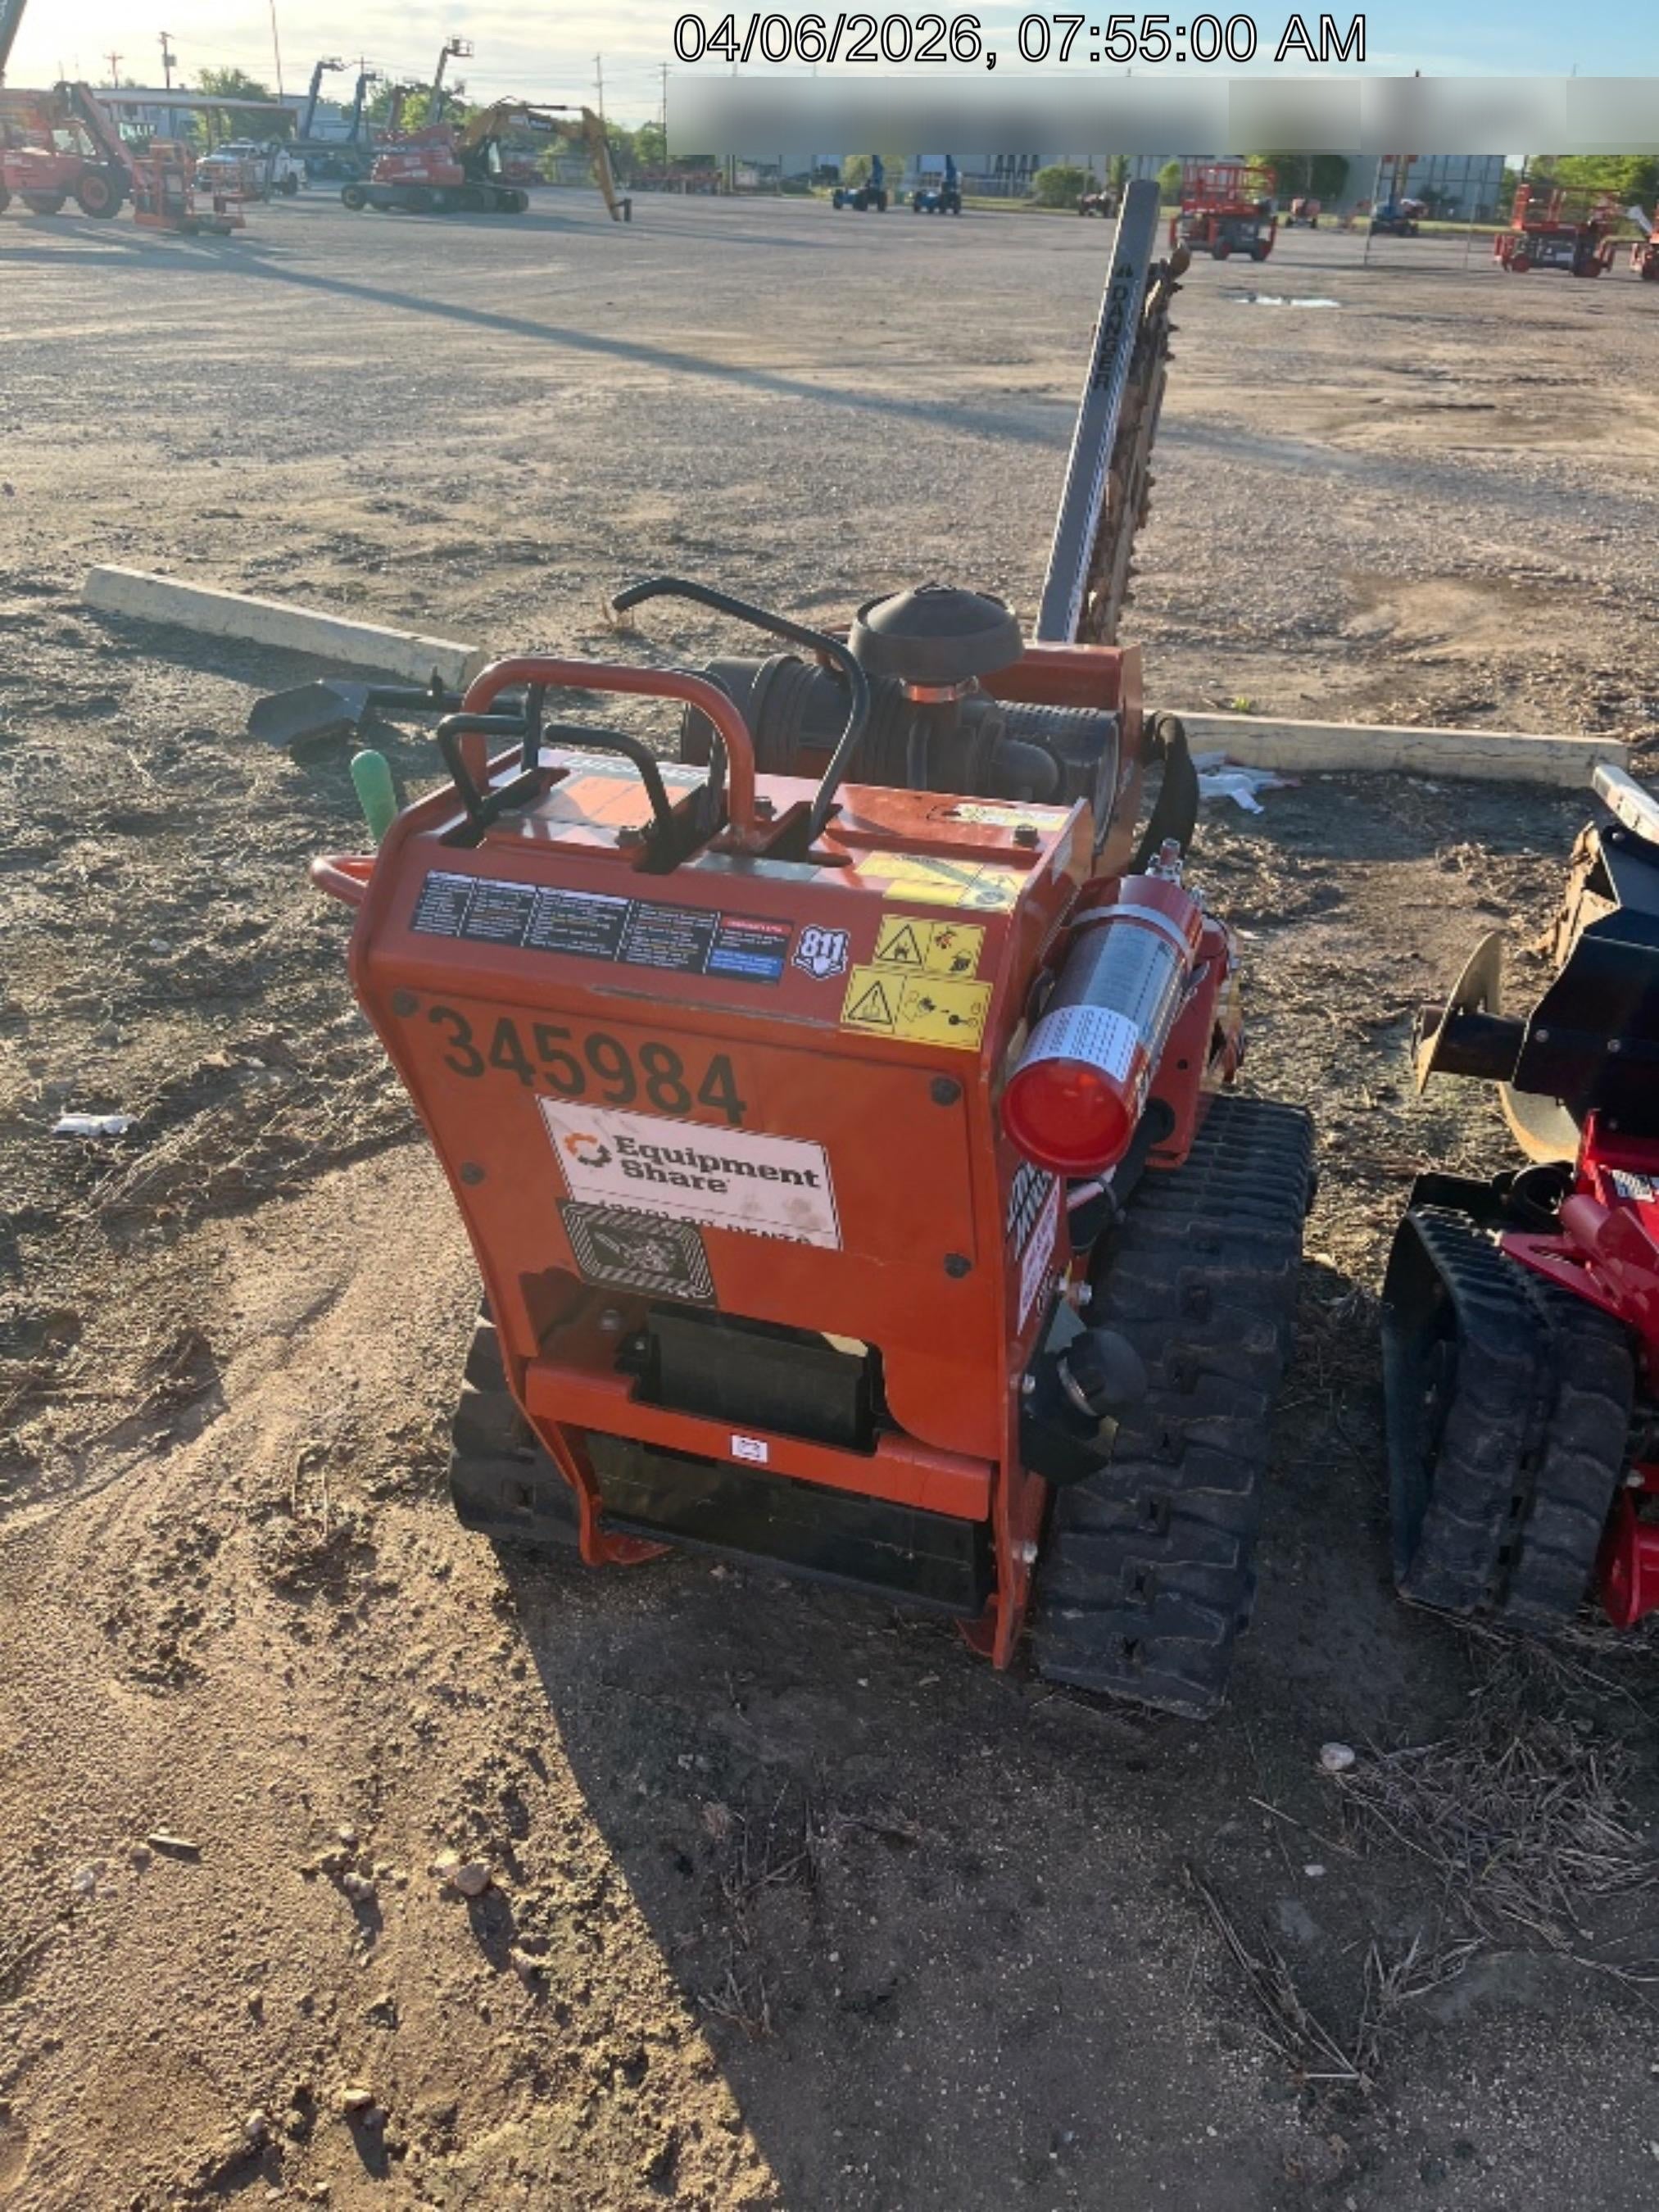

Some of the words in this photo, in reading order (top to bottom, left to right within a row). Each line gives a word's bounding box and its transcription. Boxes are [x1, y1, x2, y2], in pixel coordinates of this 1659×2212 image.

[1093, 285, 1129, 390] DANGER
[428, 1005, 747, 1126] 345984
[613, 1135, 821, 1189] Equipment
[620, 1159, 728, 1193] Share
